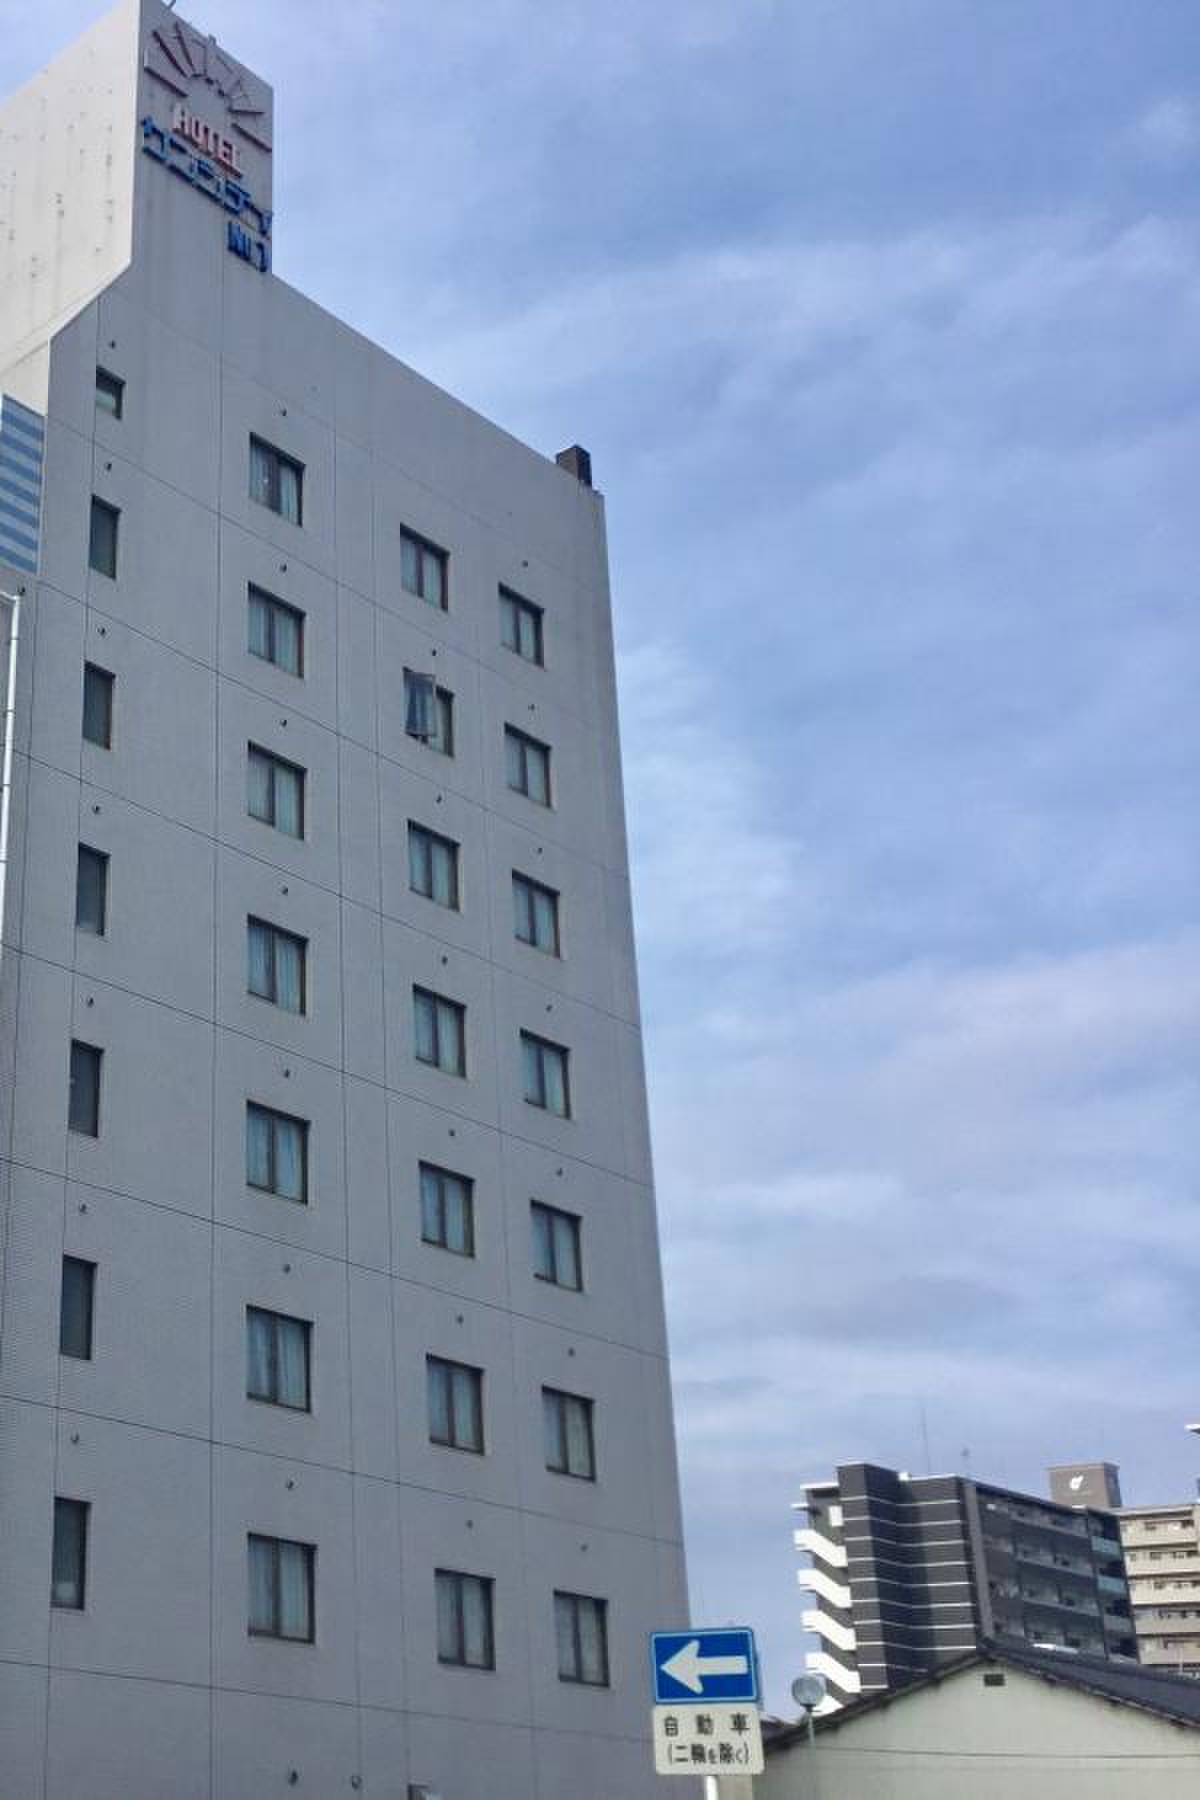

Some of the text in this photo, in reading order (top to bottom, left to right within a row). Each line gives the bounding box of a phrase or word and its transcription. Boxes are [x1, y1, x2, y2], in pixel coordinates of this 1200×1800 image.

[172, 103, 243, 178] HOTEL
[664, 1713, 750, 1737] 自動車
